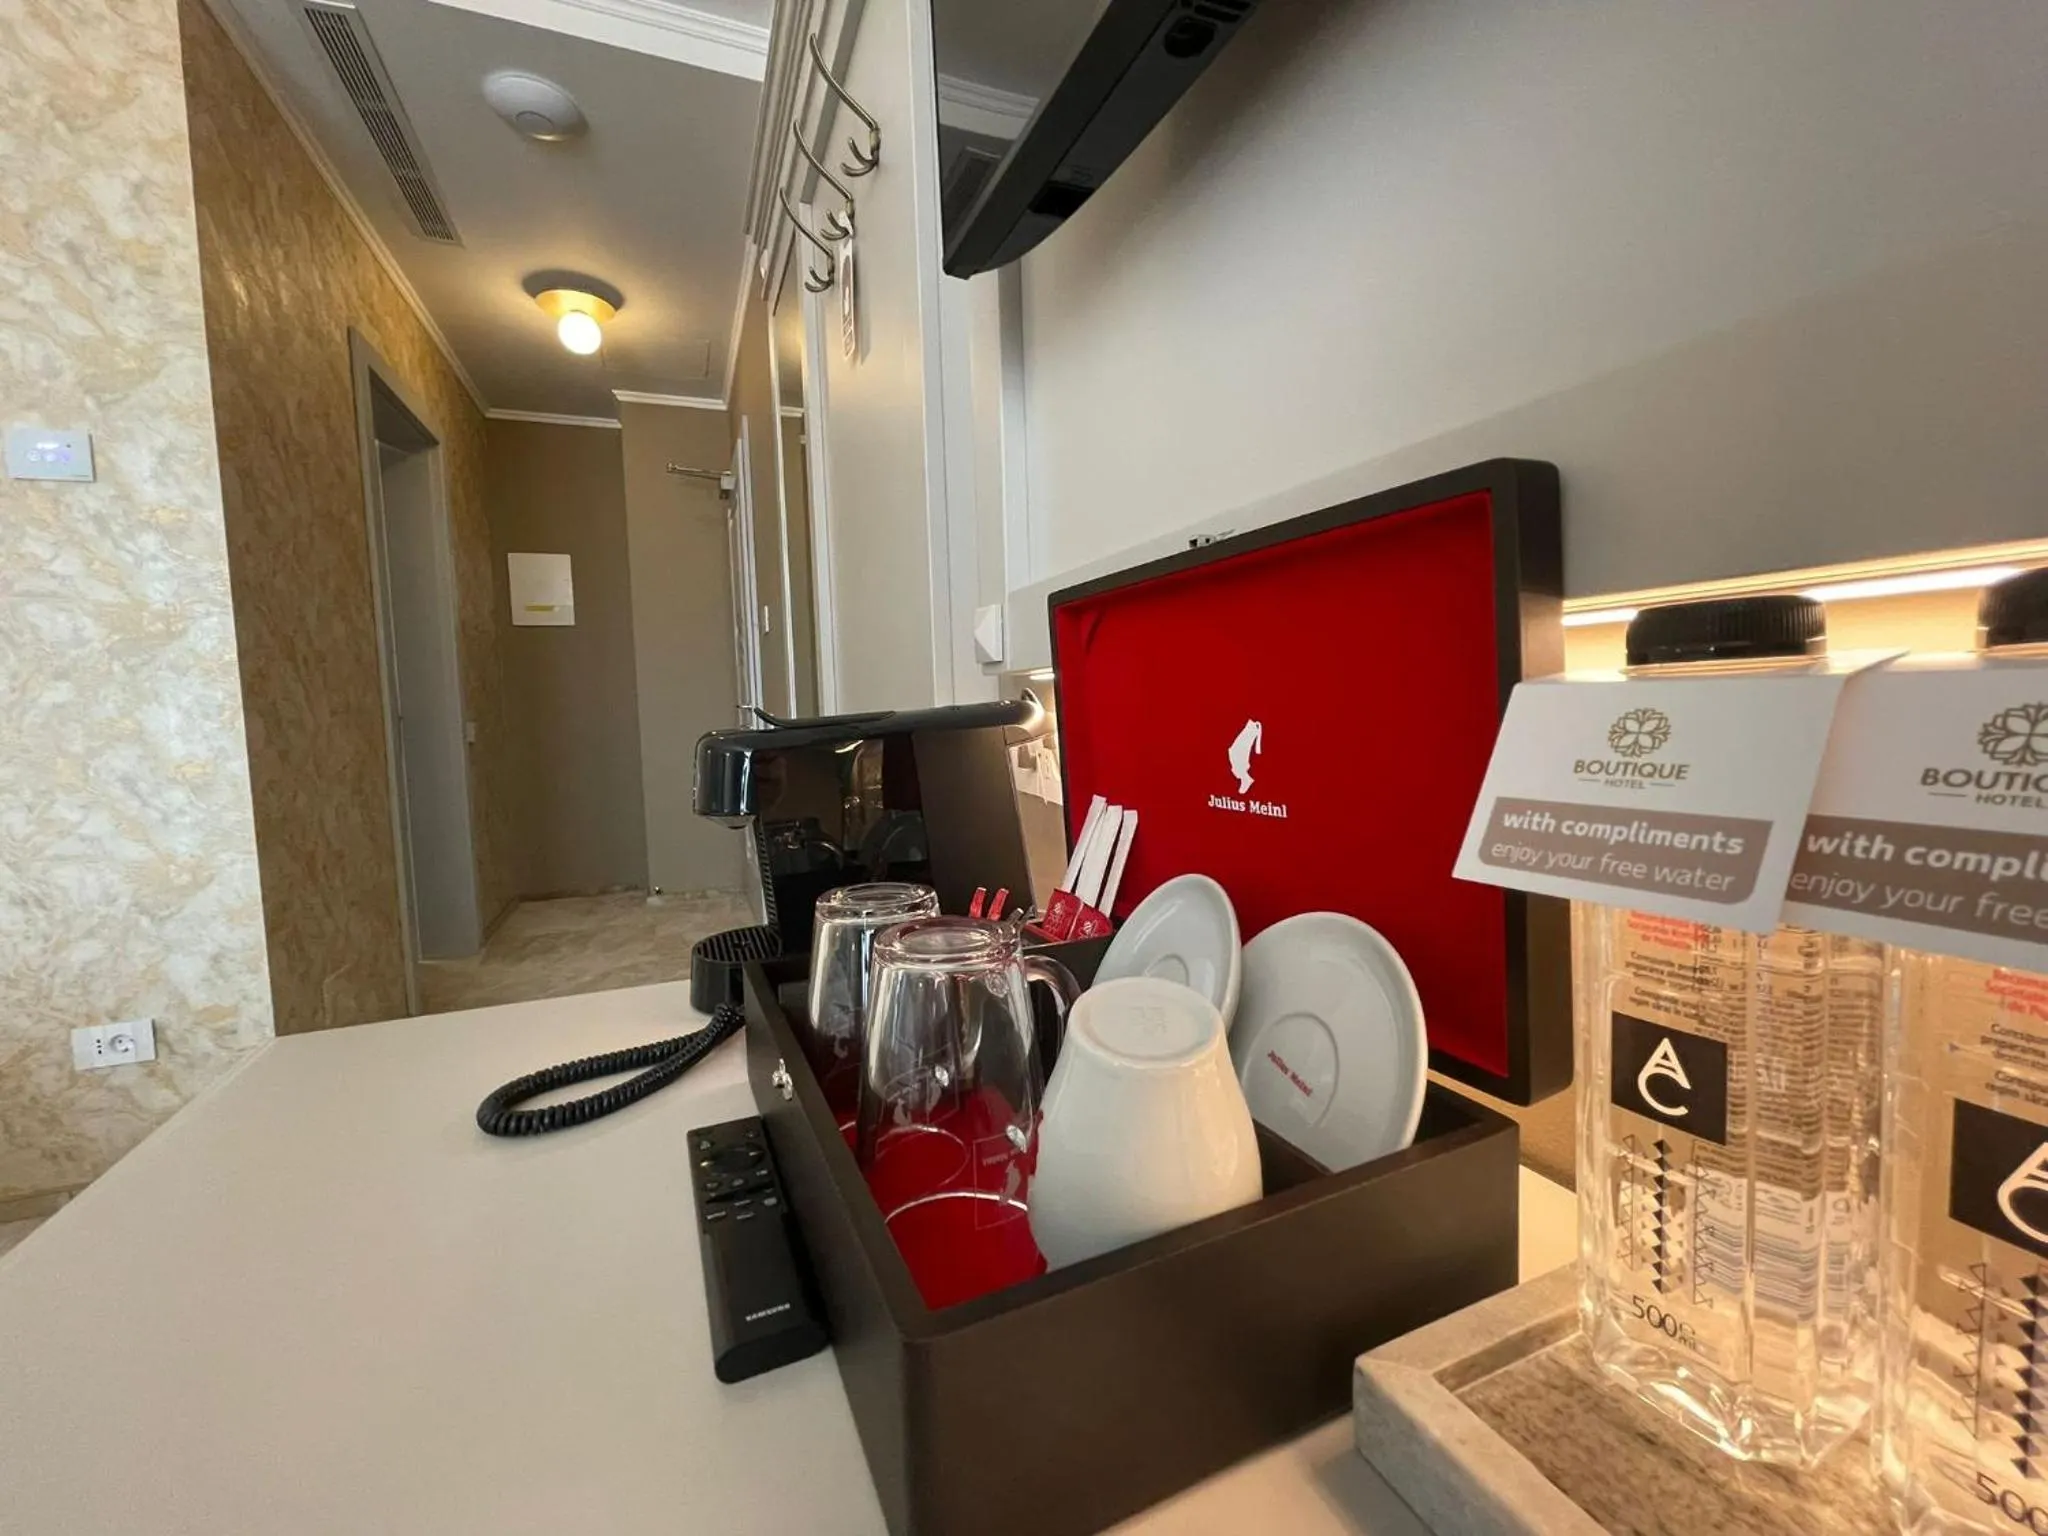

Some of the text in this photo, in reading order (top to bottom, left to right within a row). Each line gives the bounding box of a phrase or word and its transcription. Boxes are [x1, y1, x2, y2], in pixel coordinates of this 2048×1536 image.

[1573, 759, 1690, 781] BOUTIQUE
[1604, 779, 1646, 790] HOTEL
[1207, 794, 1288, 818] Julius Meinl
[1975, 792, 2048, 809] HOTEL
[1503, 809, 1746, 855] with compliments
[1806, 831, 1895, 861] with
[1491, 841, 1736, 892] enjoy your free water
[1789, 871, 2048, 930] enjoy your free
[1631, 1294, 1678, 1337] 500
[1976, 1471, 2048, 1536] 500
